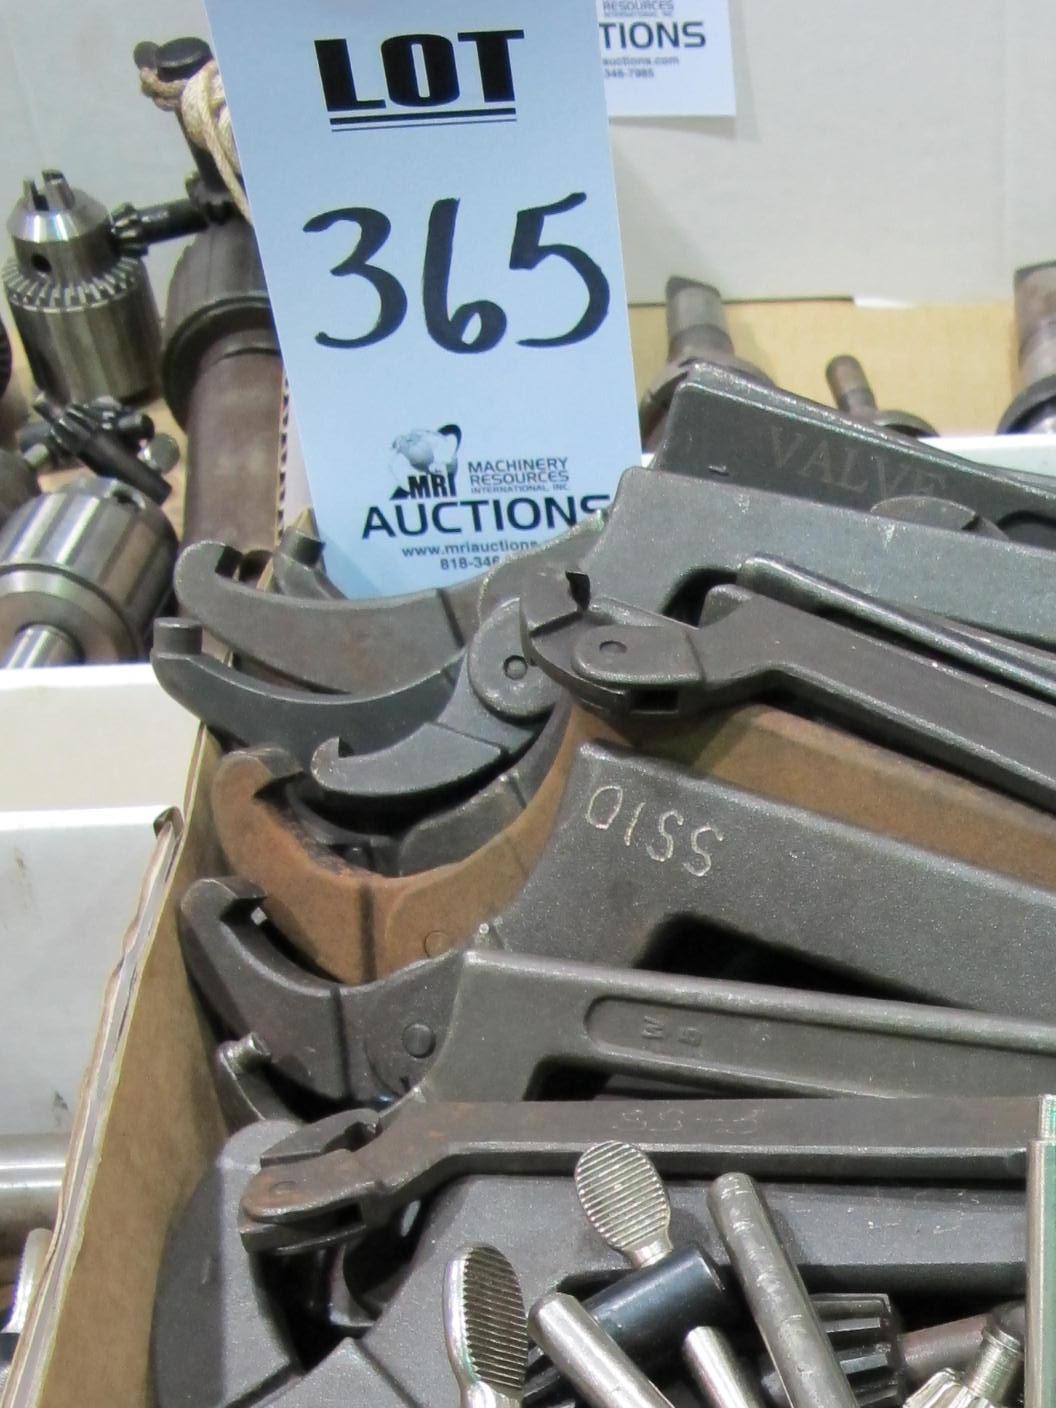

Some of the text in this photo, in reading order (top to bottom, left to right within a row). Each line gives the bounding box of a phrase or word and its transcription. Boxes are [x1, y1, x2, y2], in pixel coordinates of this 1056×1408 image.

[598, 21, 706, 49] TIONS
[314, 29, 525, 112] LOT
[602, 55, 680, 66] auctions.com
[302, 192, 610, 354] 365
[468, 457, 568, 474] MACHINERY
[469, 470, 569, 487] RESOURCES
[407, 473, 458, 500] MRI
